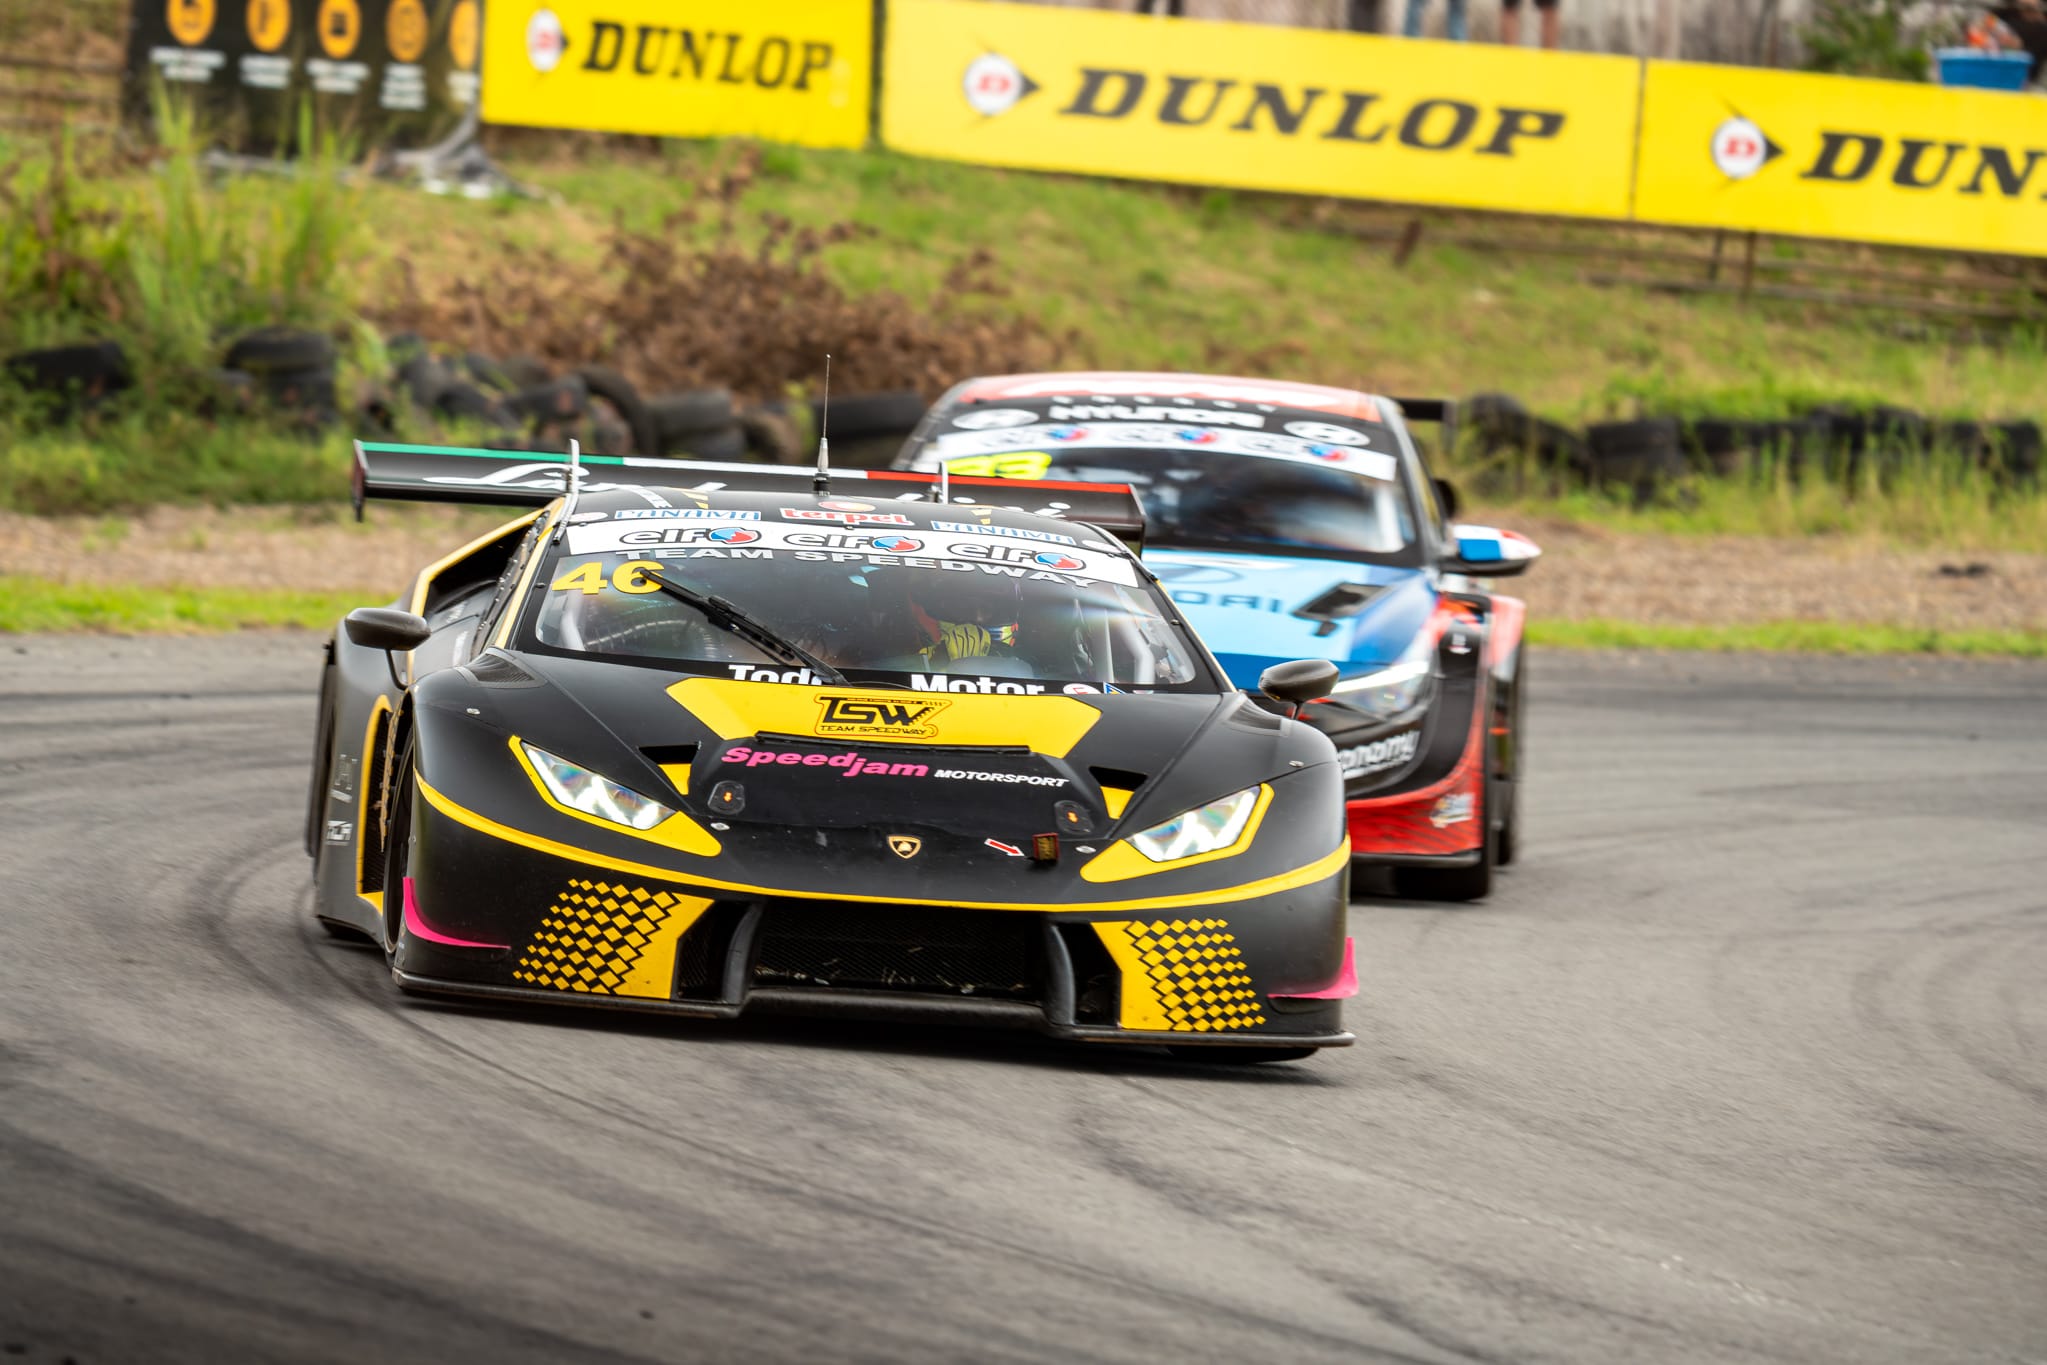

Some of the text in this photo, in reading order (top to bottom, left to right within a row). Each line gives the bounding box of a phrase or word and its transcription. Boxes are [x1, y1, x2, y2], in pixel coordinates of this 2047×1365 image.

[580, 19, 834, 91] DUNLOP
[1058, 67, 1566, 157] DUNLOP
[1797, 129, 2047, 201] DUN
[616, 510, 761, 521] PANAMA
[933, 520, 1076, 545] PANAMA
[551, 560, 665, 595] 46
[616, 549, 1098, 588] TEAM SPEEDWAY
[911, 673, 1046, 696] Motor
[819, 696, 935, 727] TSW
[820, 724, 928, 736] TEAM SPEEDWAY
[721, 746, 1070, 788] Speedjam MOTORSPORT
